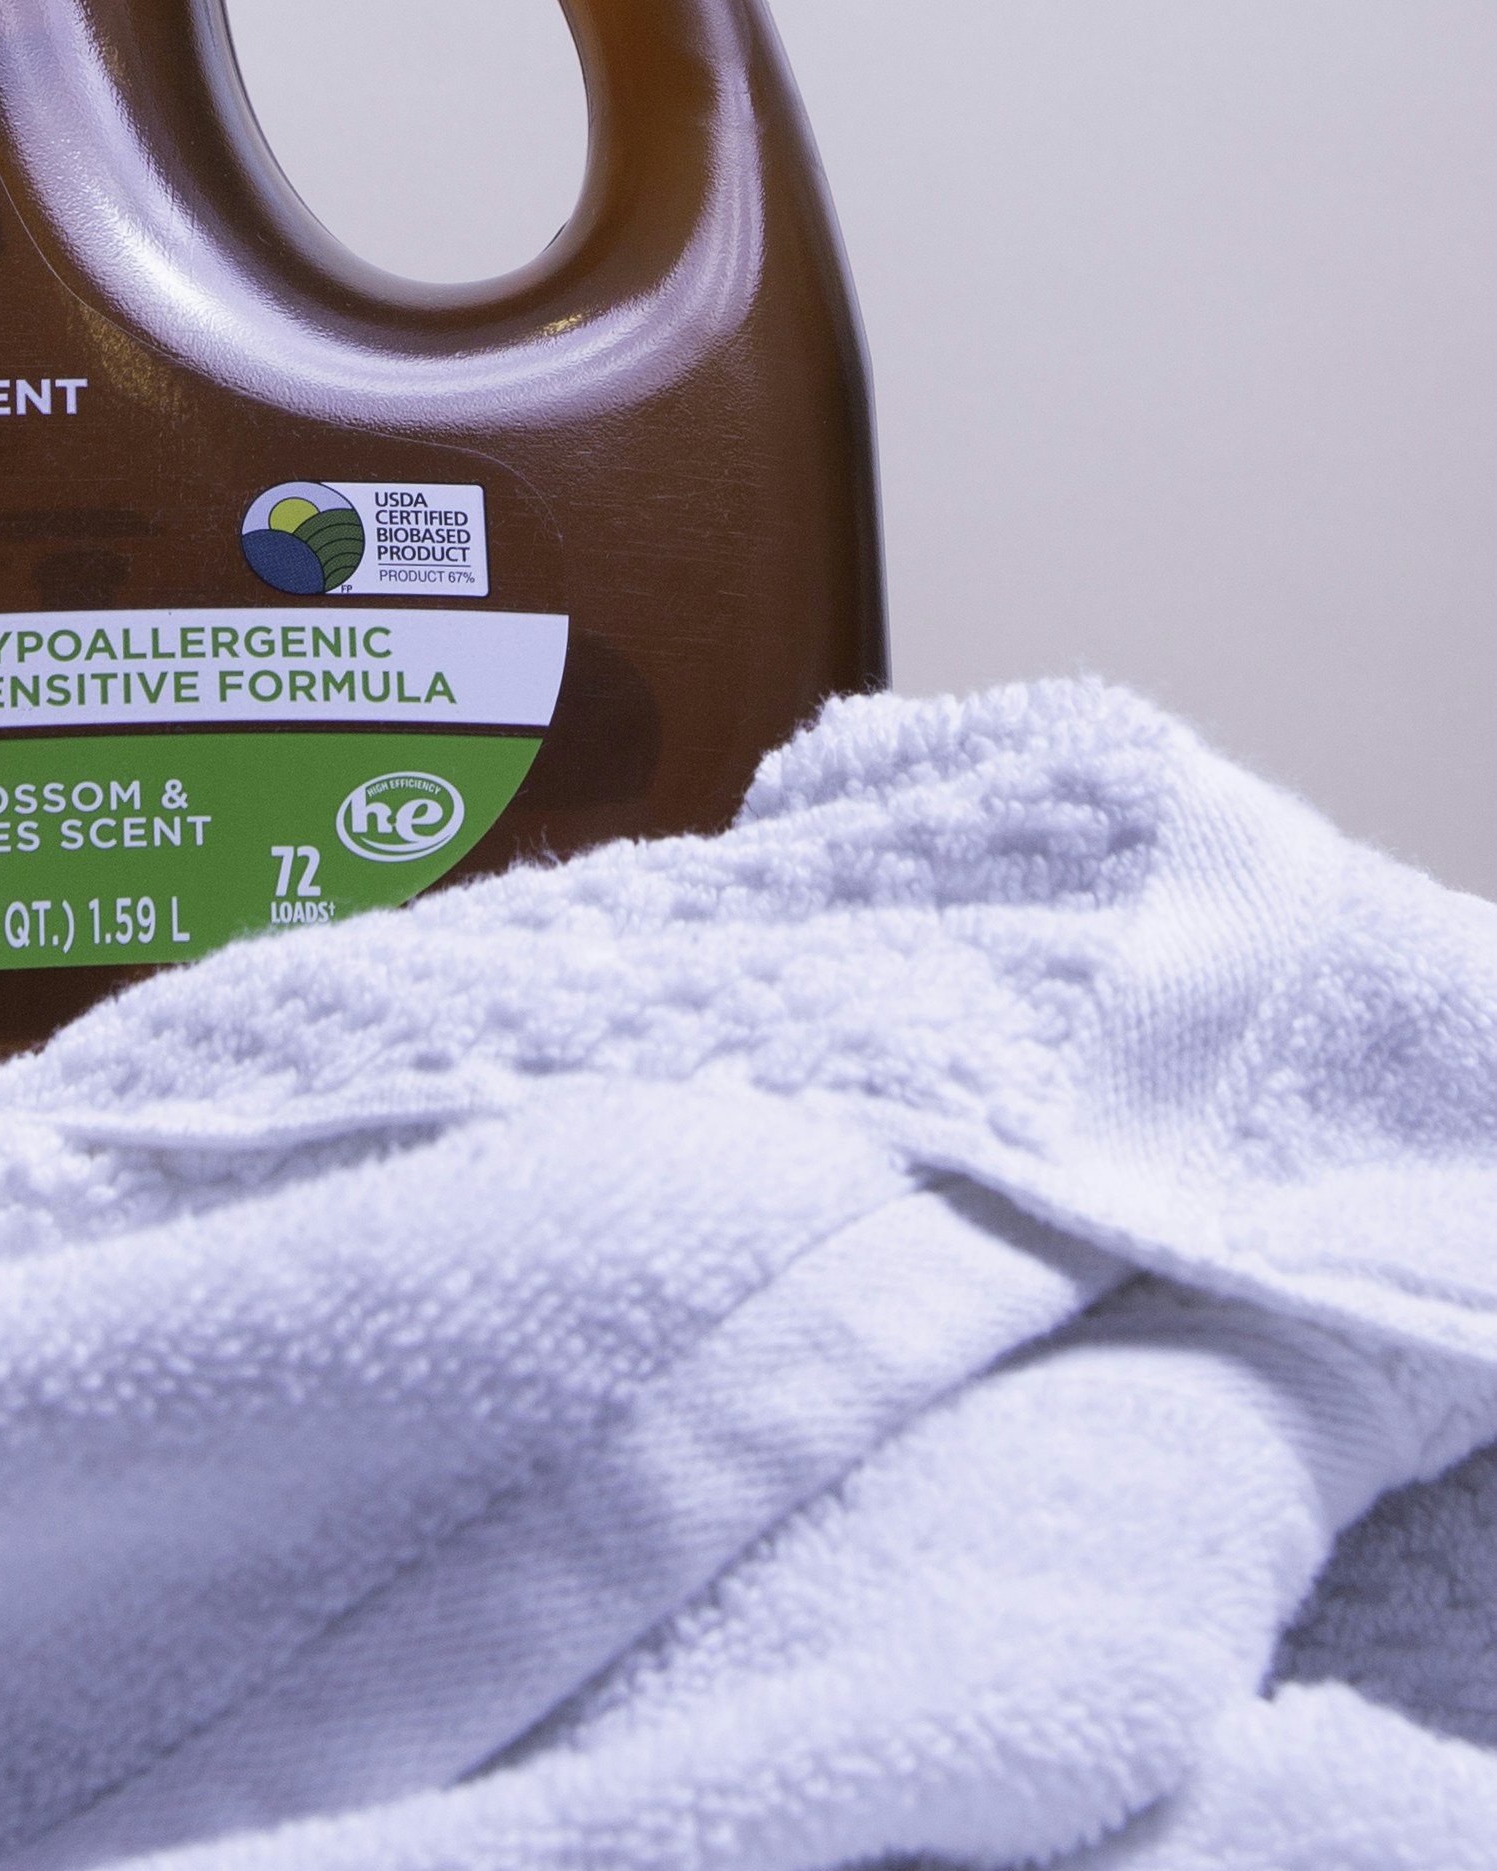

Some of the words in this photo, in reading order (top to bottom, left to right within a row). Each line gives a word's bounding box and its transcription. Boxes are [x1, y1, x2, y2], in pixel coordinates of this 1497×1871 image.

[374, 491, 428, 508] USDA
[375, 509, 469, 527] CERTIFIED
[376, 527, 471, 545] BIOBASED
[377, 545, 471, 563] PRODUCT
[379, 569, 445, 584] PRODUCT
[448, 570, 476, 584] 67%
[340, 584, 354, 594] FP
[218, 669, 458, 705] FORMULA
[160, 779, 189, 810] &
[366, 782, 389, 798] HIGH
[389, 778, 442, 796] EFFICIENCY
[351, 786, 444, 843] he
[59, 815, 212, 851] SCENT
[270, 845, 322, 897] 72
[4, 899, 75, 955] QT.)
[88, 895, 157, 946] 1.59
[170, 895, 191, 944] L
